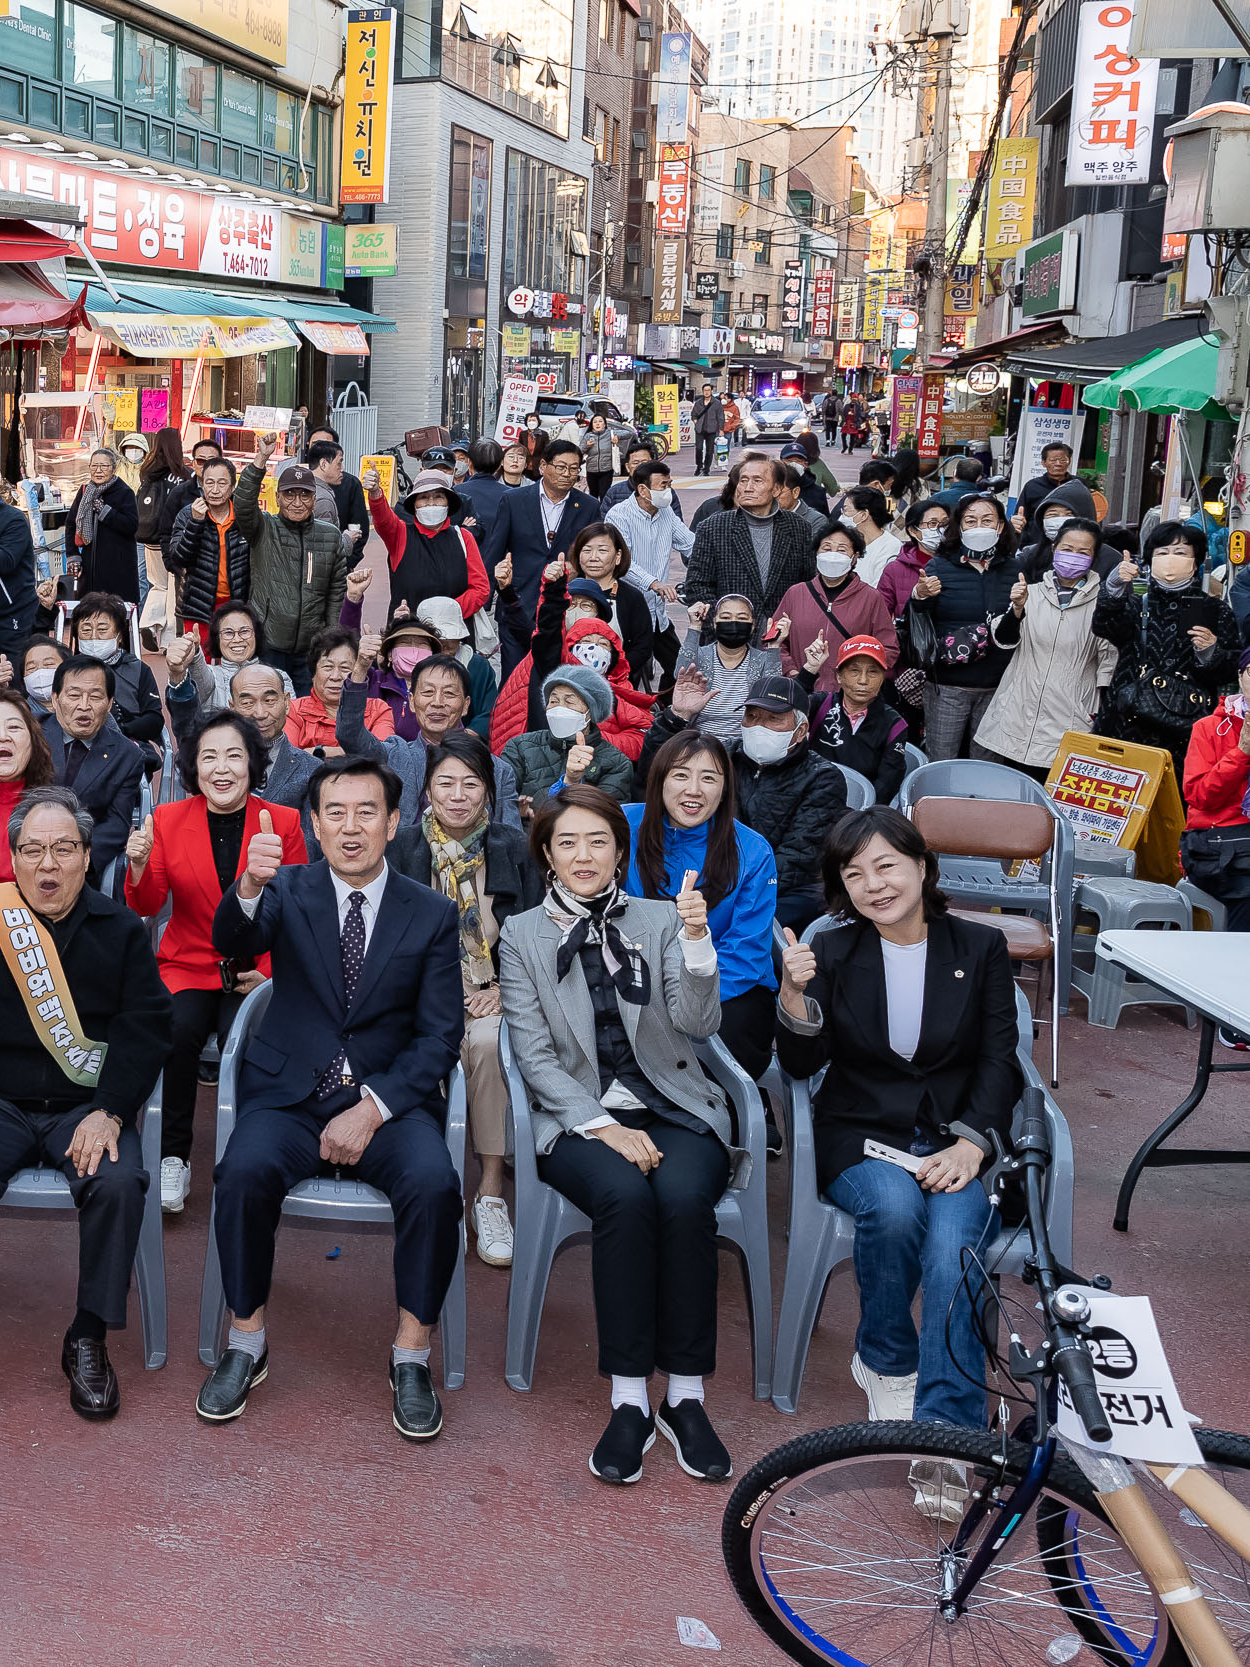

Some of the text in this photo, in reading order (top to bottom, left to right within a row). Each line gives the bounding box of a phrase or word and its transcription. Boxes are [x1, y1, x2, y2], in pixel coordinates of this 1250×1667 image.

[18, 19, 37, 36] Dental
[37, 27, 52, 42] Clinic
[1084, 161, 1138, 174] 맥주 양주
[660, 161, 687, 227] 부동산
[996, 155, 1028, 244] 中国食品
[218, 205, 273, 251] 상주축산
[299, 229, 316, 255] 농협
[352, 232, 385, 249] 365
[352, 250, 389, 259] Auto Bank
[659, 242, 679, 311] 금은보석시계
[514, 293, 529, 308] 약
[510, 382, 534, 394] OPEN
[897, 378, 920, 391] 한국
[971, 371, 997, 385] 커피
[656, 391, 676, 402] 황소
[922, 384, 940, 447] 中国食品
[1034, 417, 1071, 430] 삼성생명
[1057, 774, 1136, 818] 주차금지
[740, 1490, 772, 1529] COMPASS
